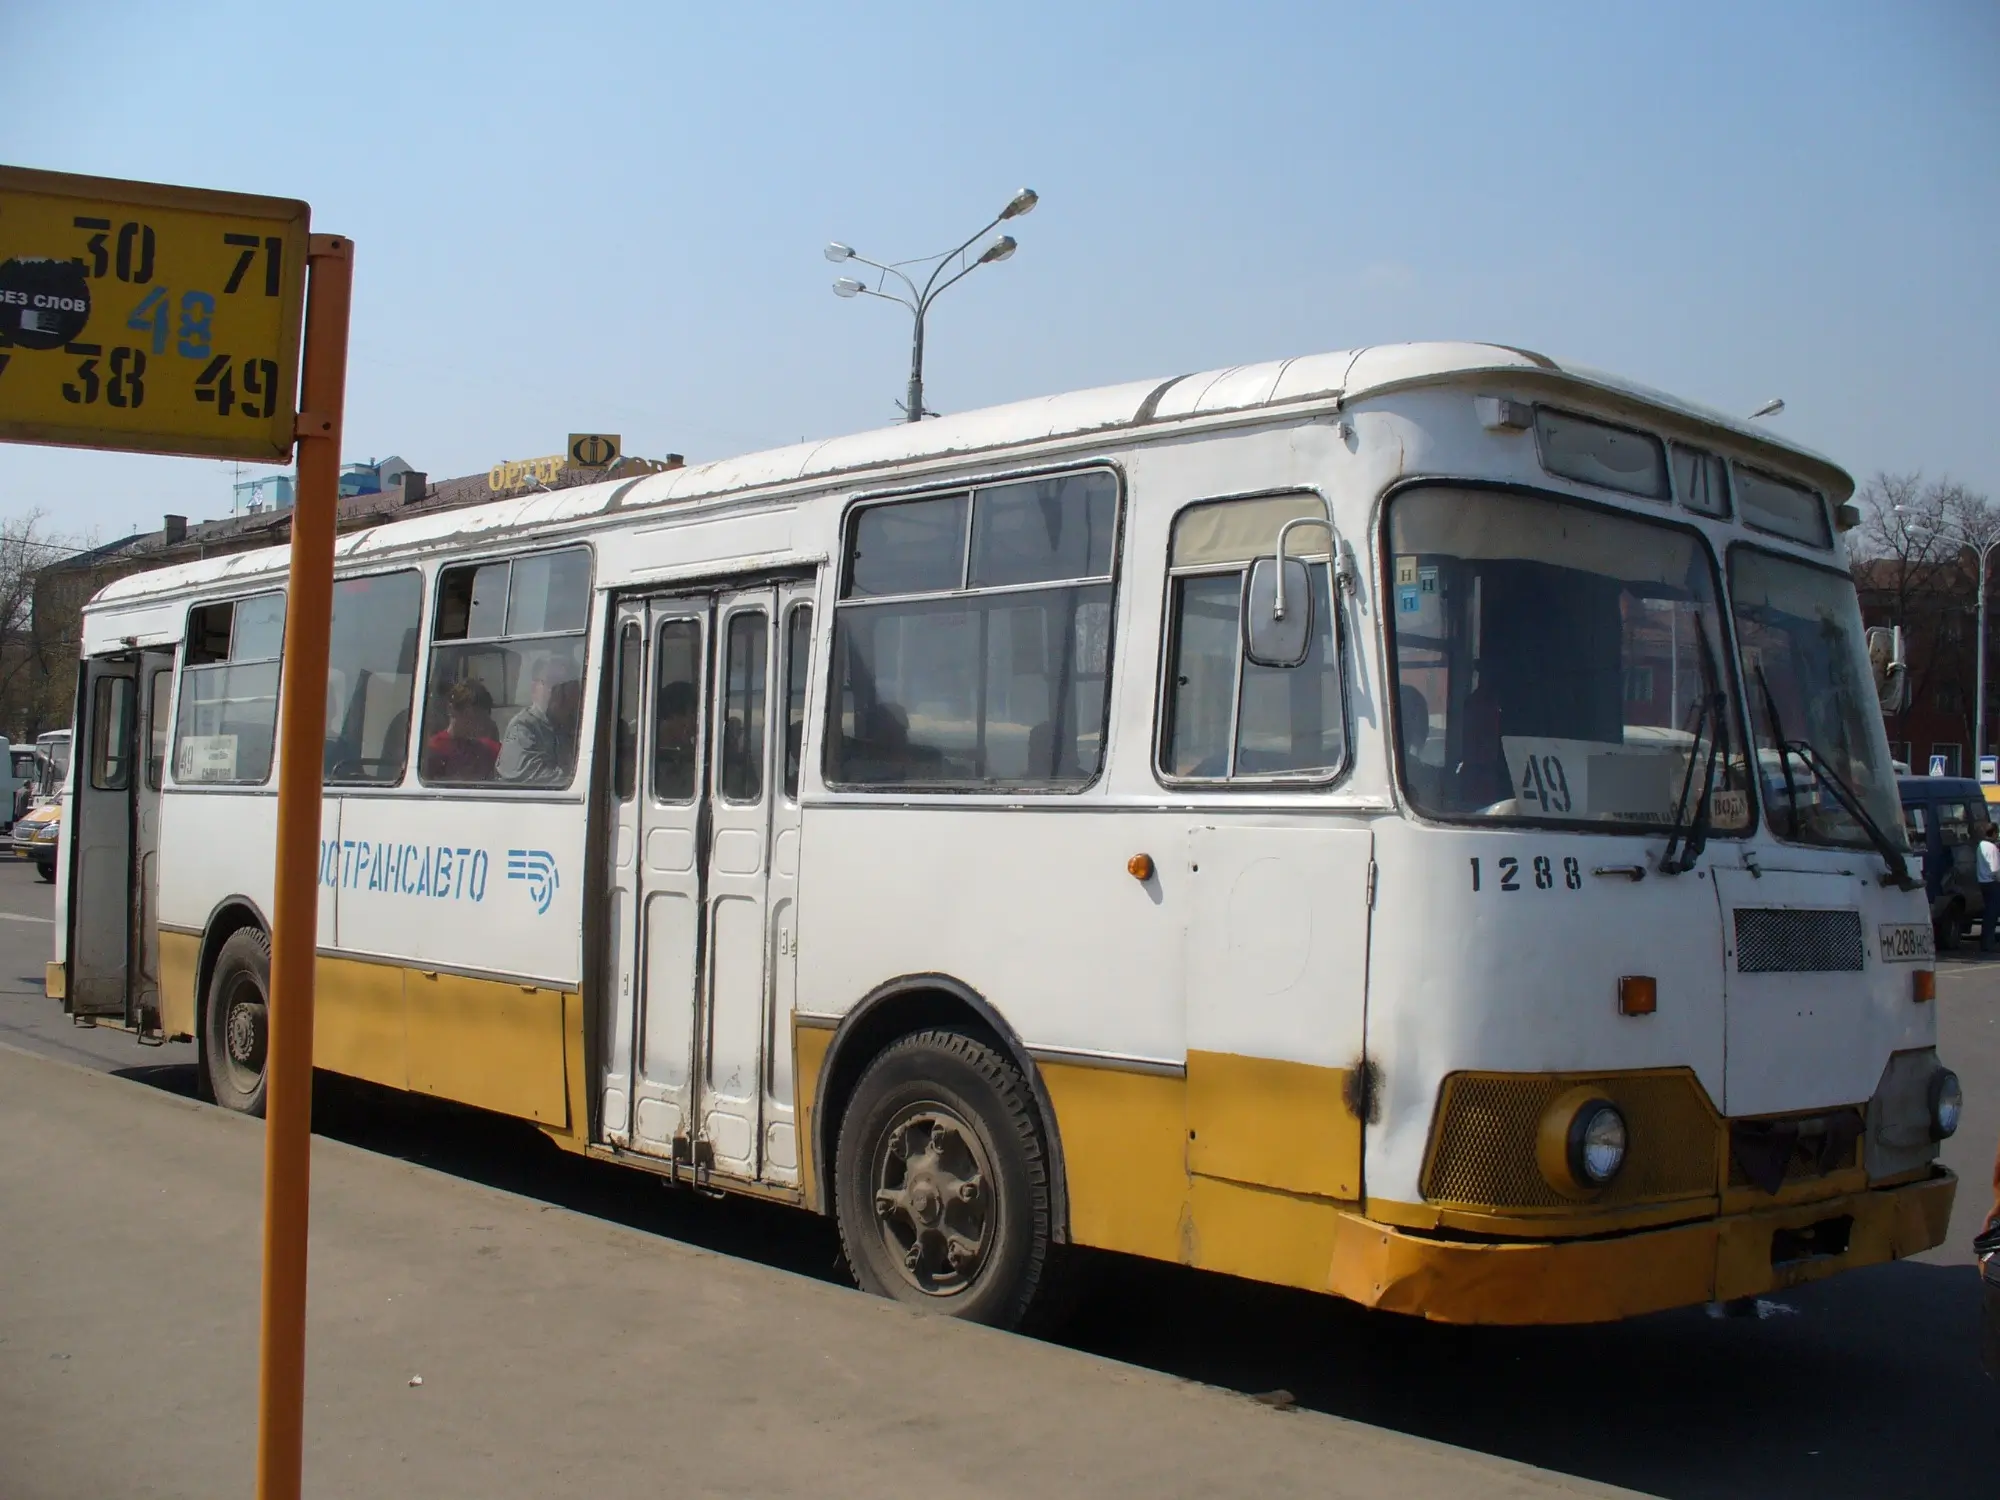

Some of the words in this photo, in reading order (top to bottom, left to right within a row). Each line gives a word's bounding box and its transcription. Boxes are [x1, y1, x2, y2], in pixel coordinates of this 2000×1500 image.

[71, 217, 156, 284] 30
[223, 233, 282, 297] 71
[33, 294, 86, 312] СЛОВ
[127, 286, 215, 360] 48
[62, 342, 146, 409] 38
[194, 355, 278, 419] 49
[1522, 755, 1572, 813] 49
[1470, 856, 1582, 892] 1288
